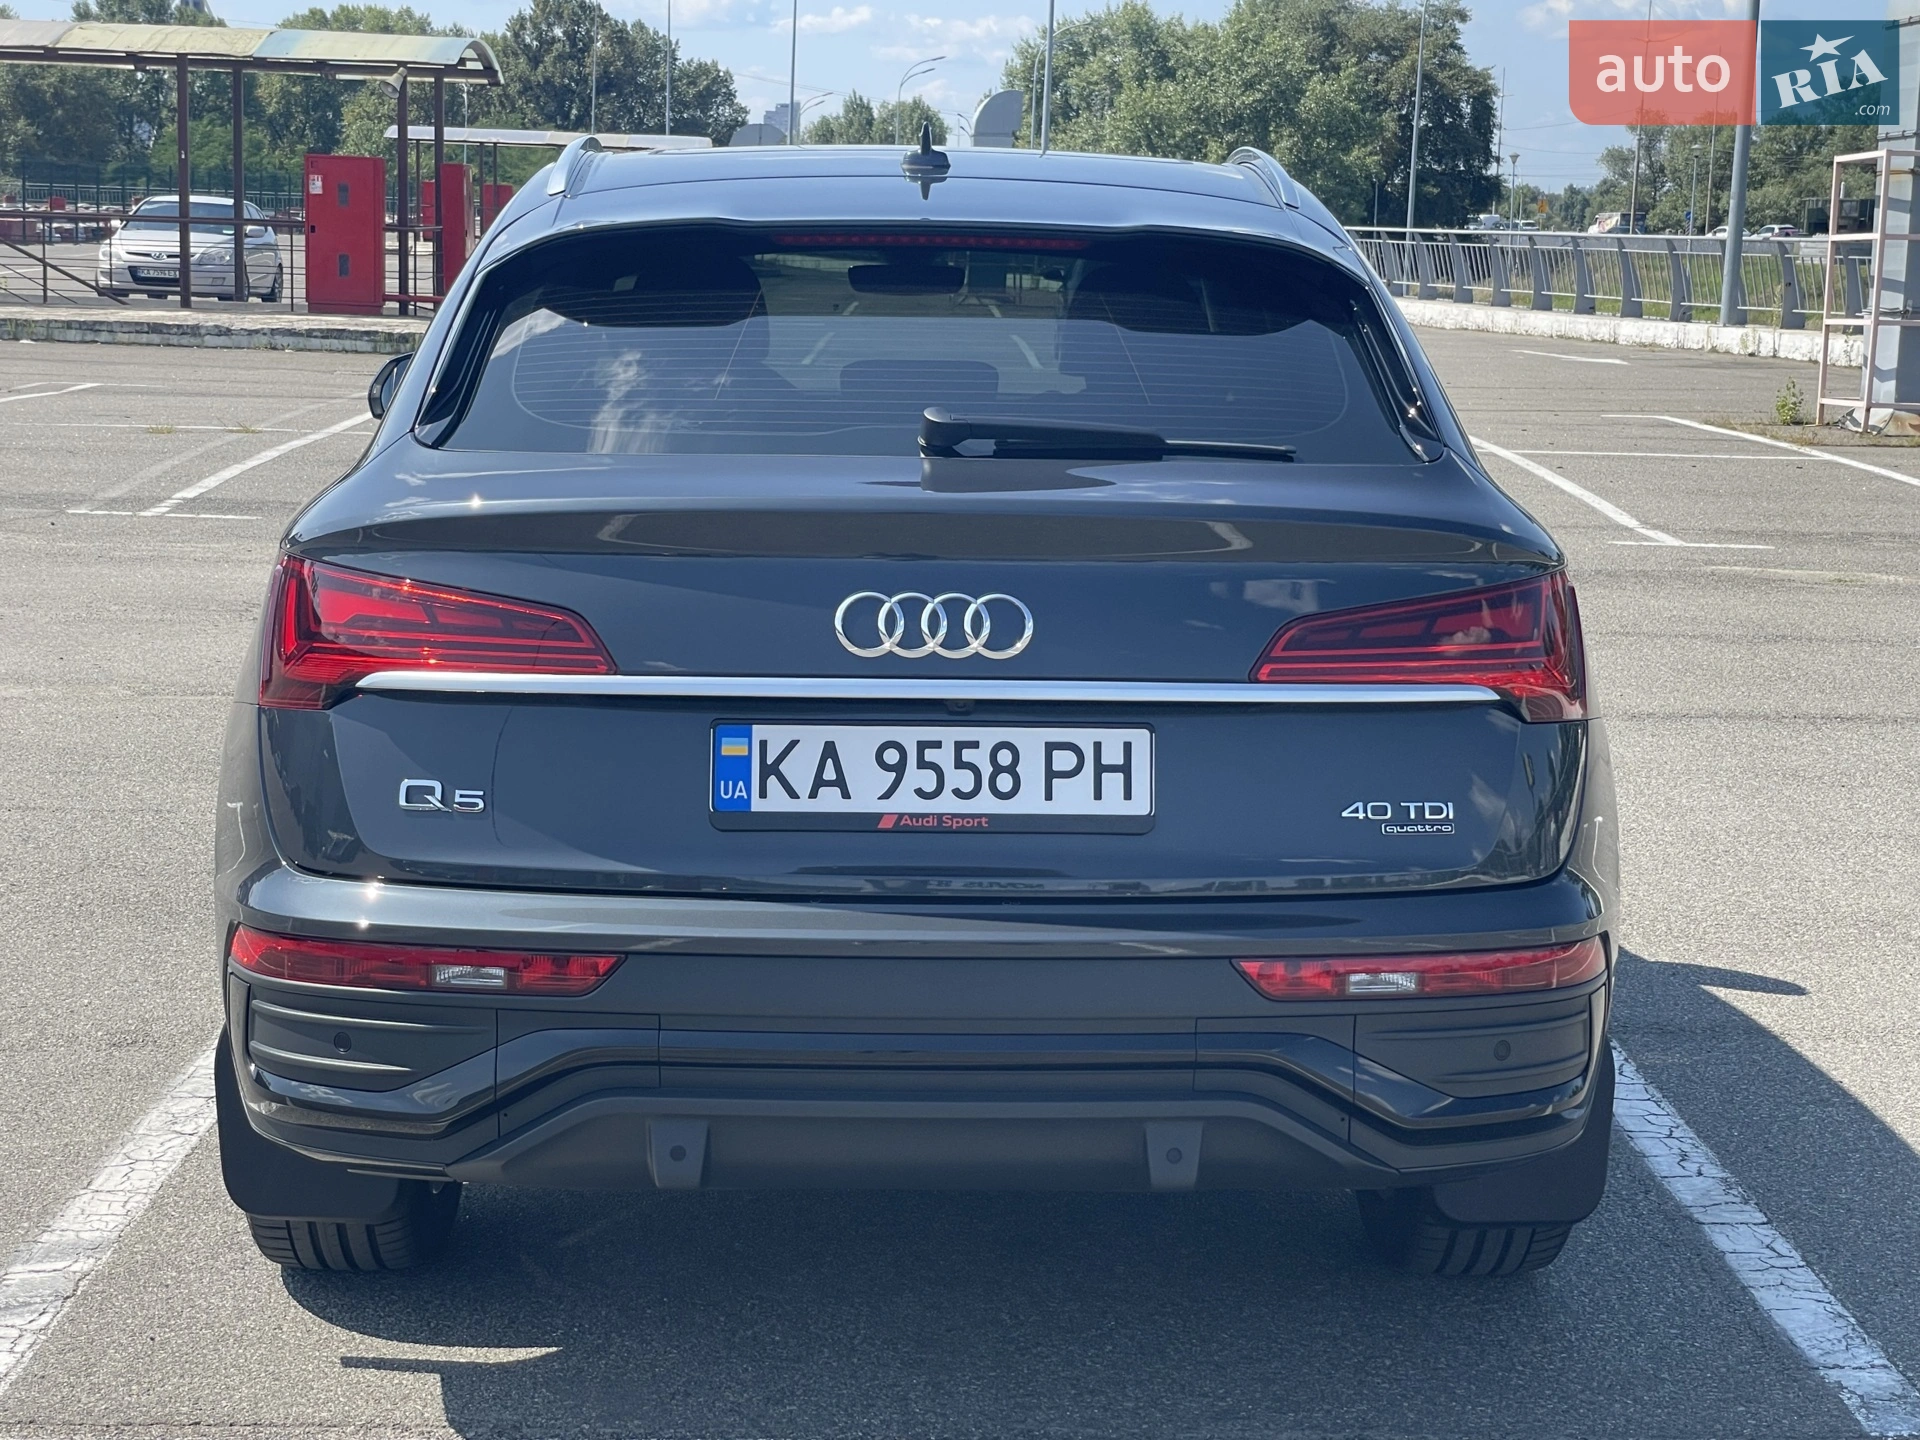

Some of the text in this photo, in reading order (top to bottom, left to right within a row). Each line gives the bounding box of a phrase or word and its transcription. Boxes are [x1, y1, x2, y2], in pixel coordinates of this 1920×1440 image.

[758, 739, 1133, 801] KA 9558 PH
[399, 779, 485, 813] Q5
[720, 780, 748, 799] UA
[1341, 801, 1454, 820] 40 TDI
[899, 815, 989, 830] Audi Sport
[1386, 824, 1452, 834] quattro
